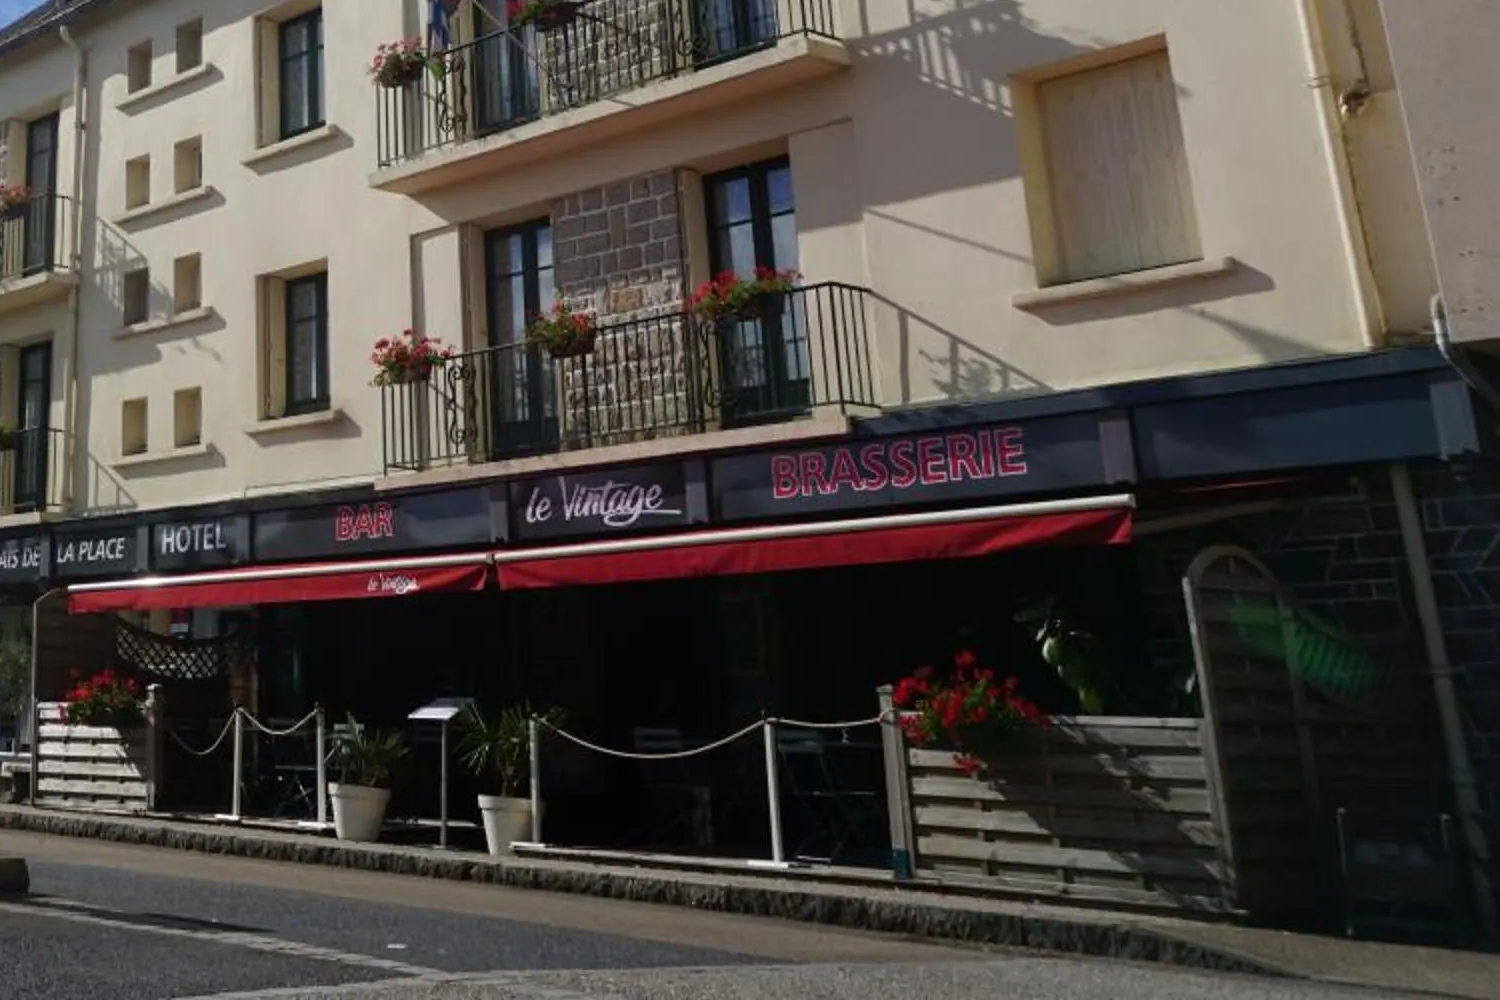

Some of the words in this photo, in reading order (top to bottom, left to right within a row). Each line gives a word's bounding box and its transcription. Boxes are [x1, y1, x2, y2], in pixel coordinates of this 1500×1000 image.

[770, 427, 1028, 499] BRASSERIE
[335, 503, 394, 541] BAR
[558, 475, 682, 527] Vintage
[22, 546, 41, 567] DE
[57, 542, 75, 563] LA
[78, 537, 125, 561] PLACE
